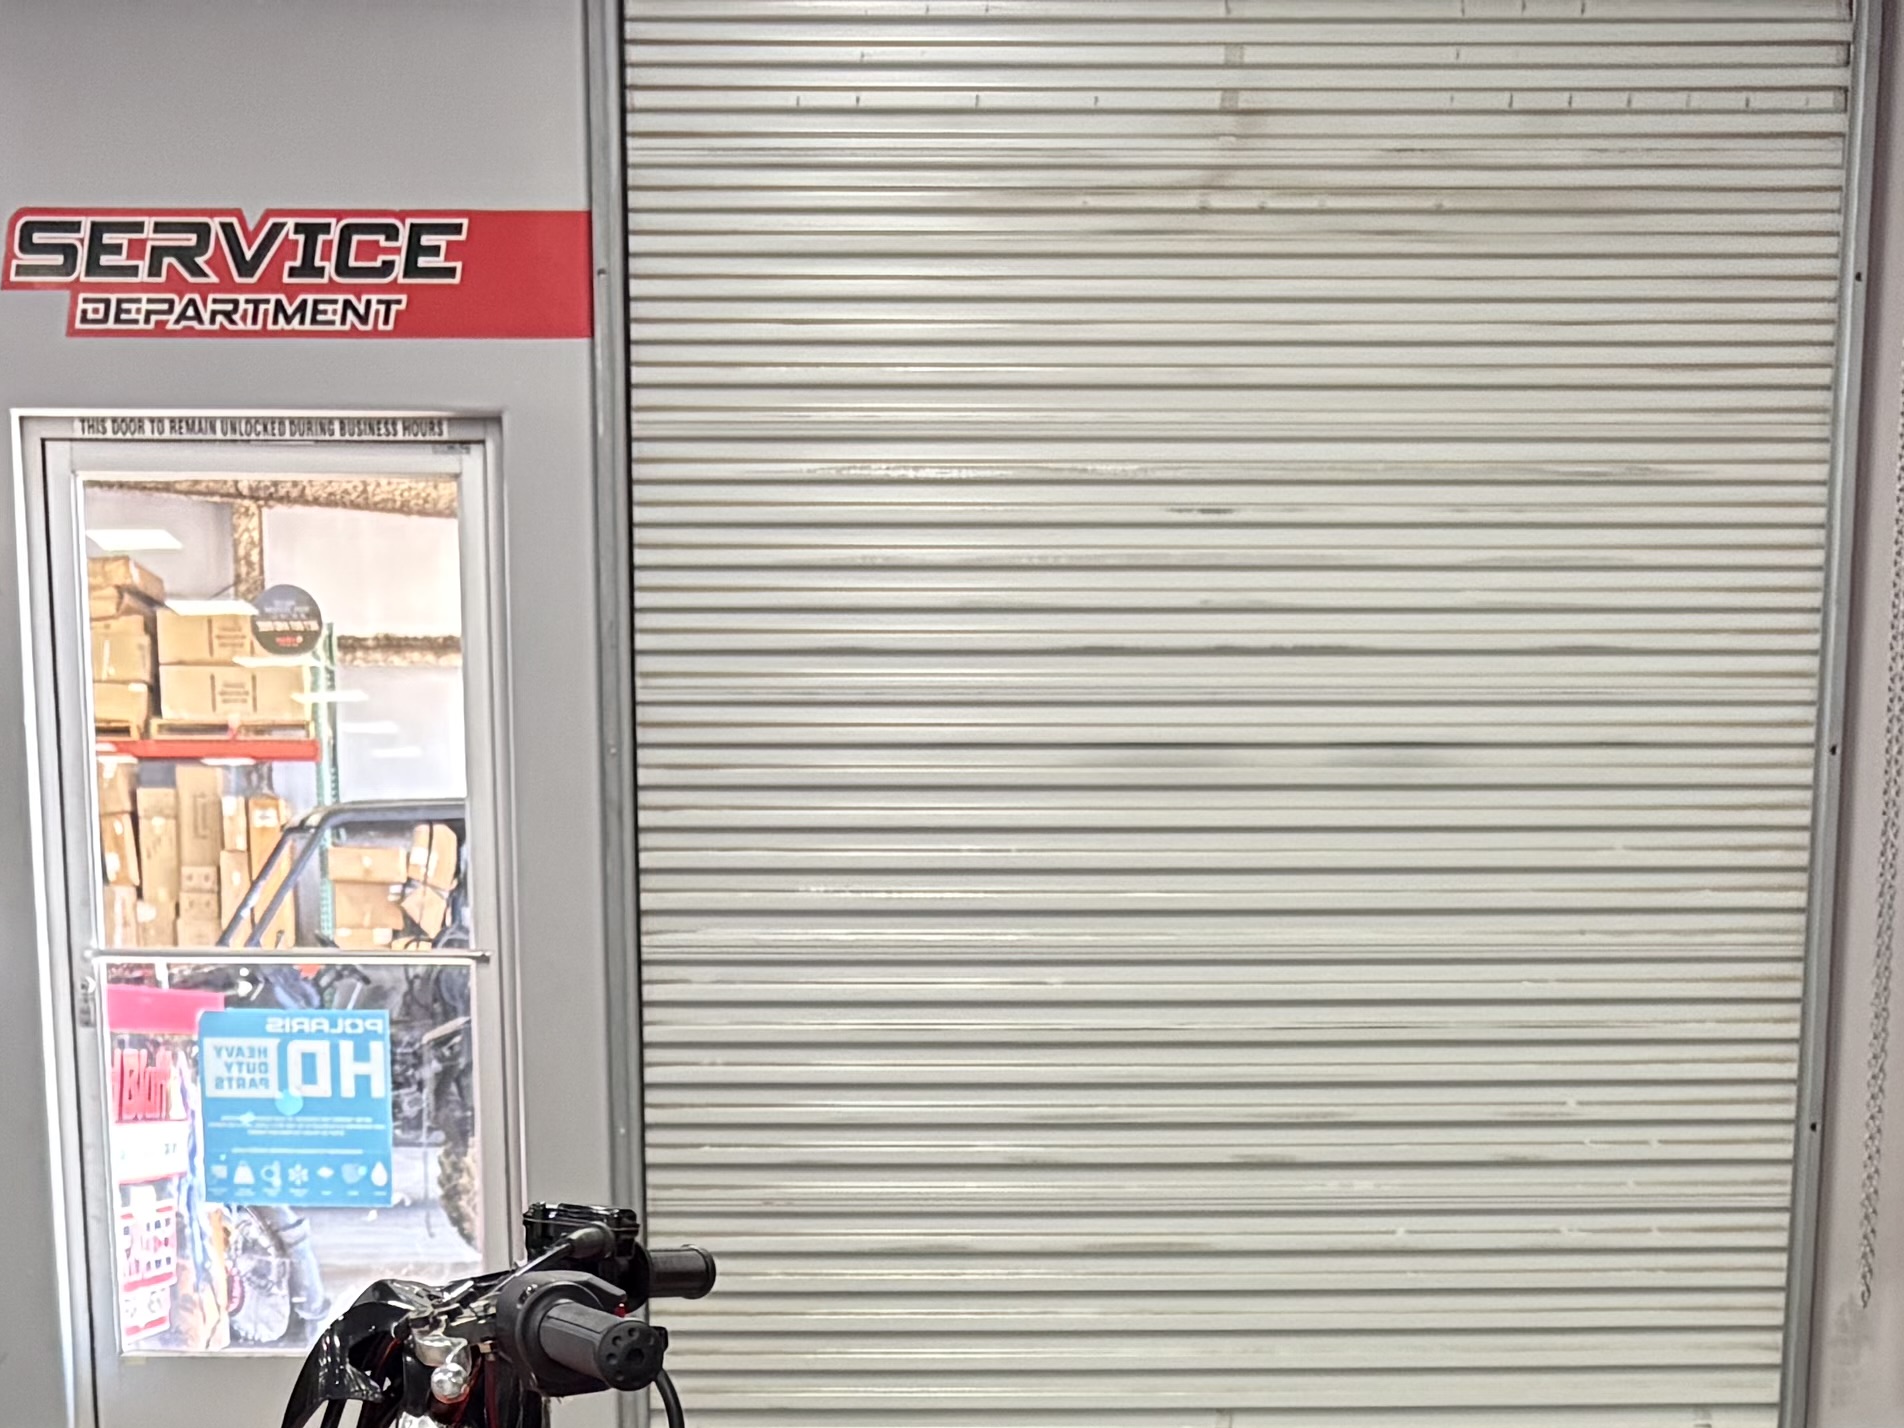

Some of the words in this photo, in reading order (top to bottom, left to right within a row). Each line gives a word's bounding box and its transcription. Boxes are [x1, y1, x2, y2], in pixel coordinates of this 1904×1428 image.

[10, 216, 469, 285] SERVICE
[75, 294, 408, 331] DEPARTMENT
[79, 417, 108, 438] THIS
[111, 417, 146, 438] DOOR
[149, 417, 166, 438] TO
[168, 417, 217, 438] REMAIN
[220, 417, 286, 438] UNLOCKED
[289, 417, 335, 438] DURING
[339, 417, 398, 438] BUSINESS
[401, 417, 446, 438] HOURS
